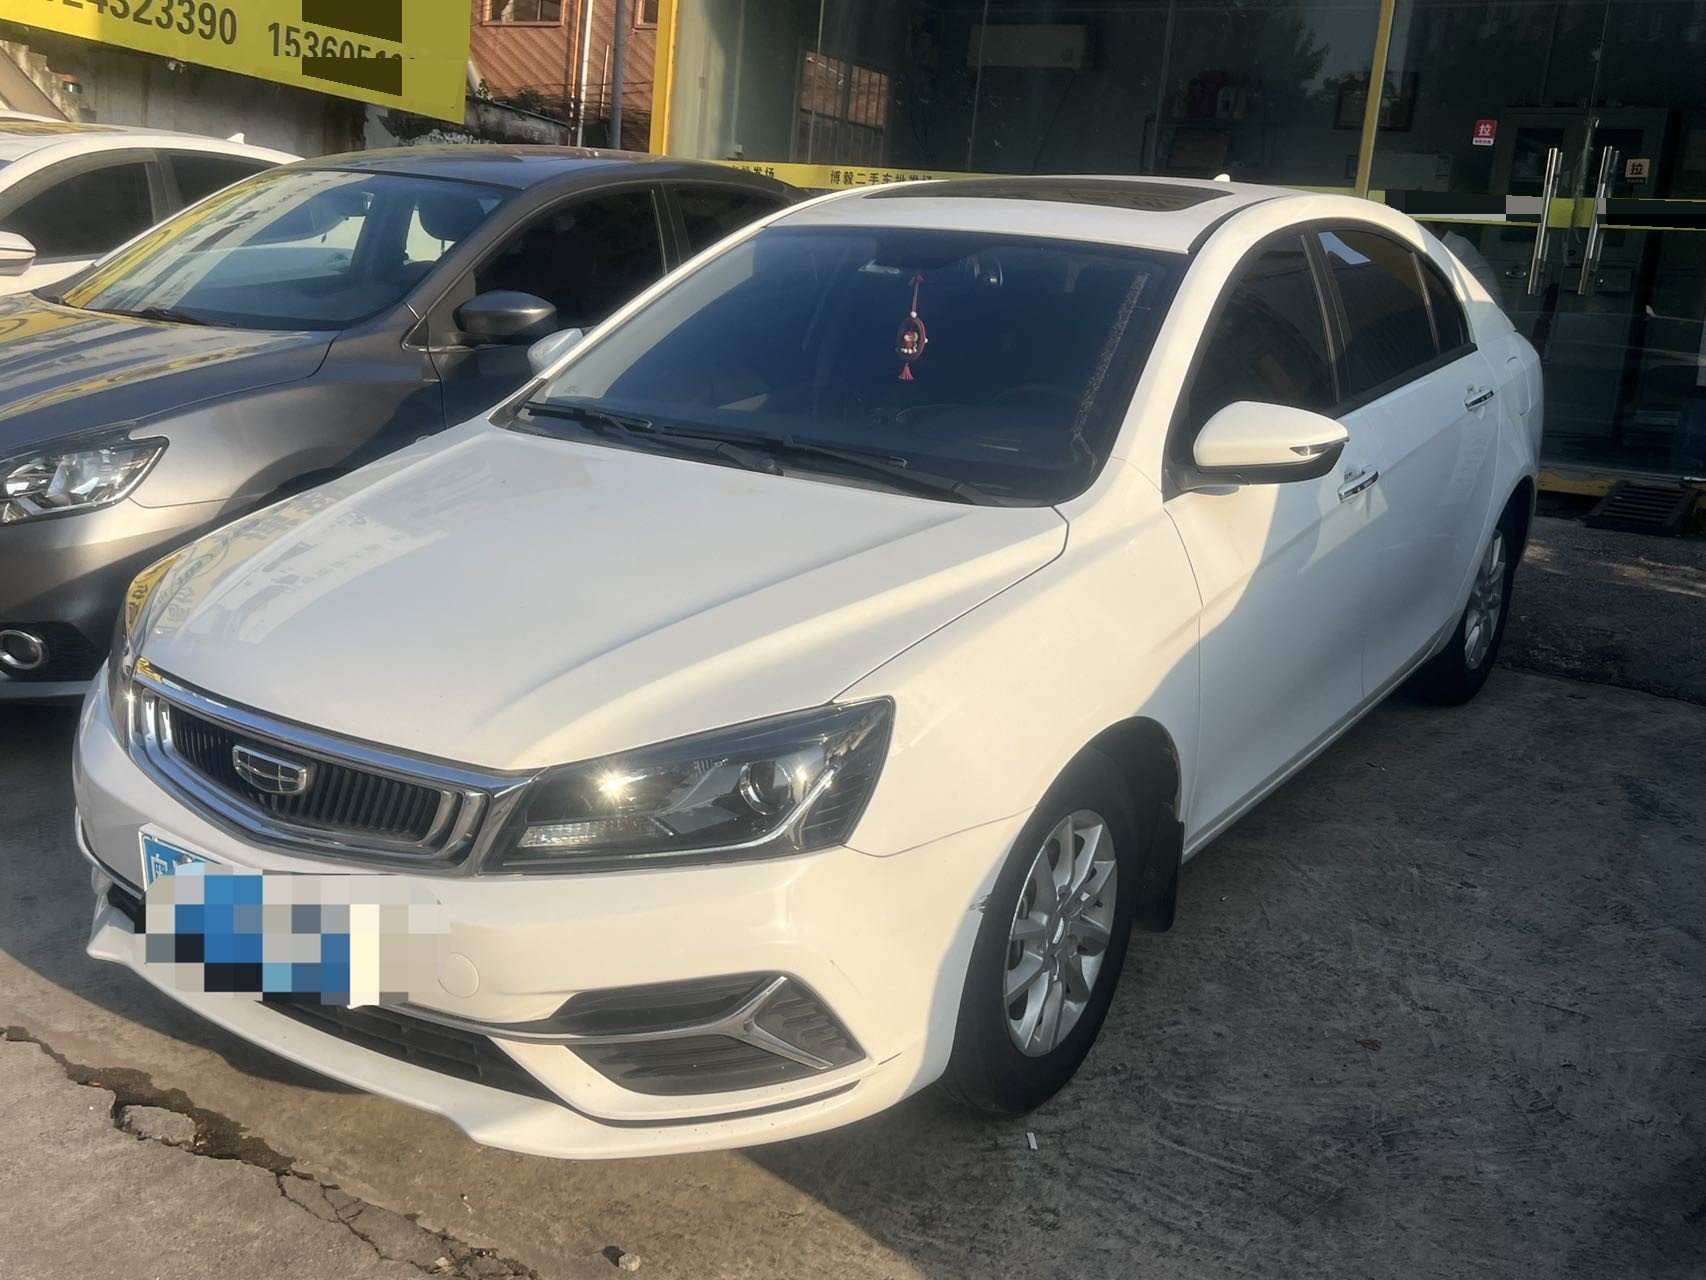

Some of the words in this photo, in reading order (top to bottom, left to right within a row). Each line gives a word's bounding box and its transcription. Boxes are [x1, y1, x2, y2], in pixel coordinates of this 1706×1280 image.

[268, 22, 402, 58] 15360
[1479, 123, 1492, 136] 拉
[1630, 162, 1644, 175] 拉
